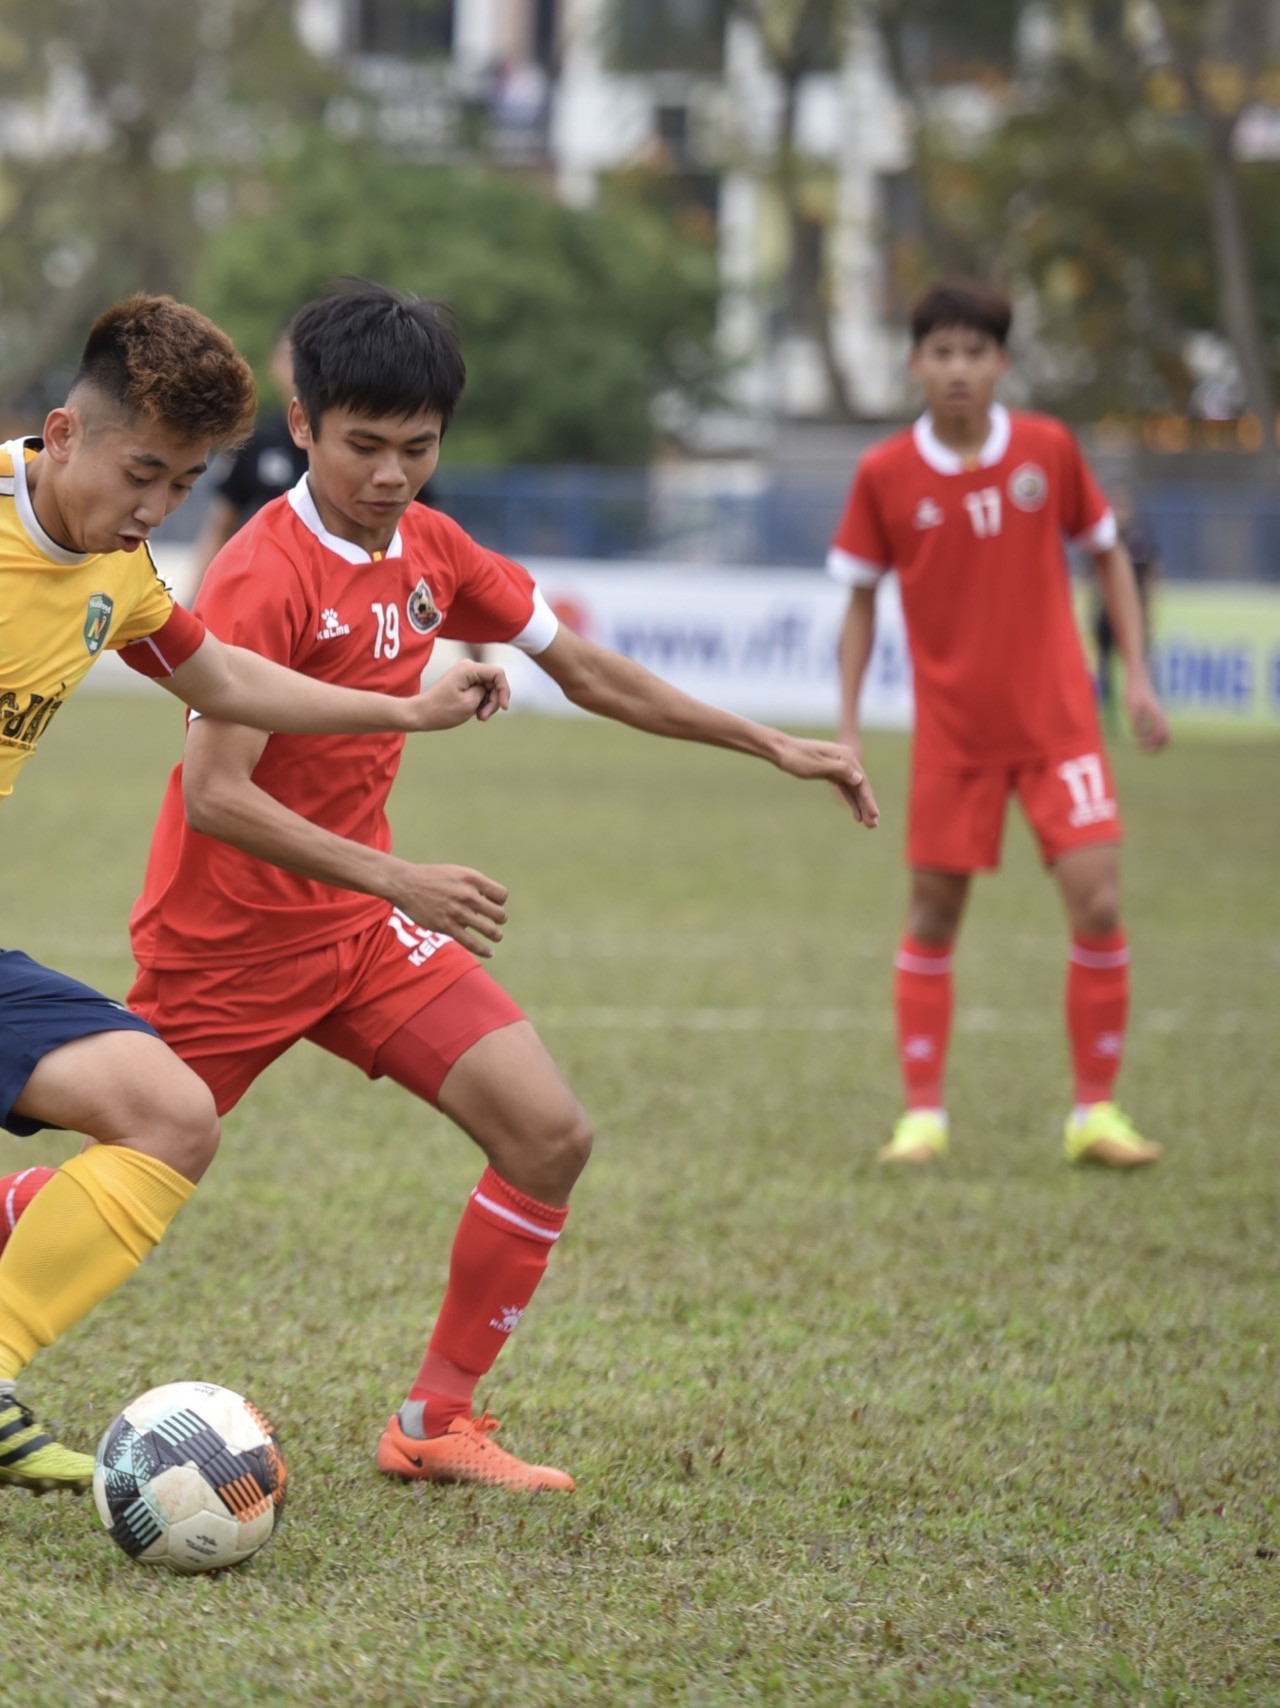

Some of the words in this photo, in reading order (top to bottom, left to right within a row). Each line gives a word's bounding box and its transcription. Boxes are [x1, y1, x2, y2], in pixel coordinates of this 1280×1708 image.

[964, 486, 1002, 539] 17
[372, 602, 400, 659] 19
[1057, 753, 1105, 806] 17
